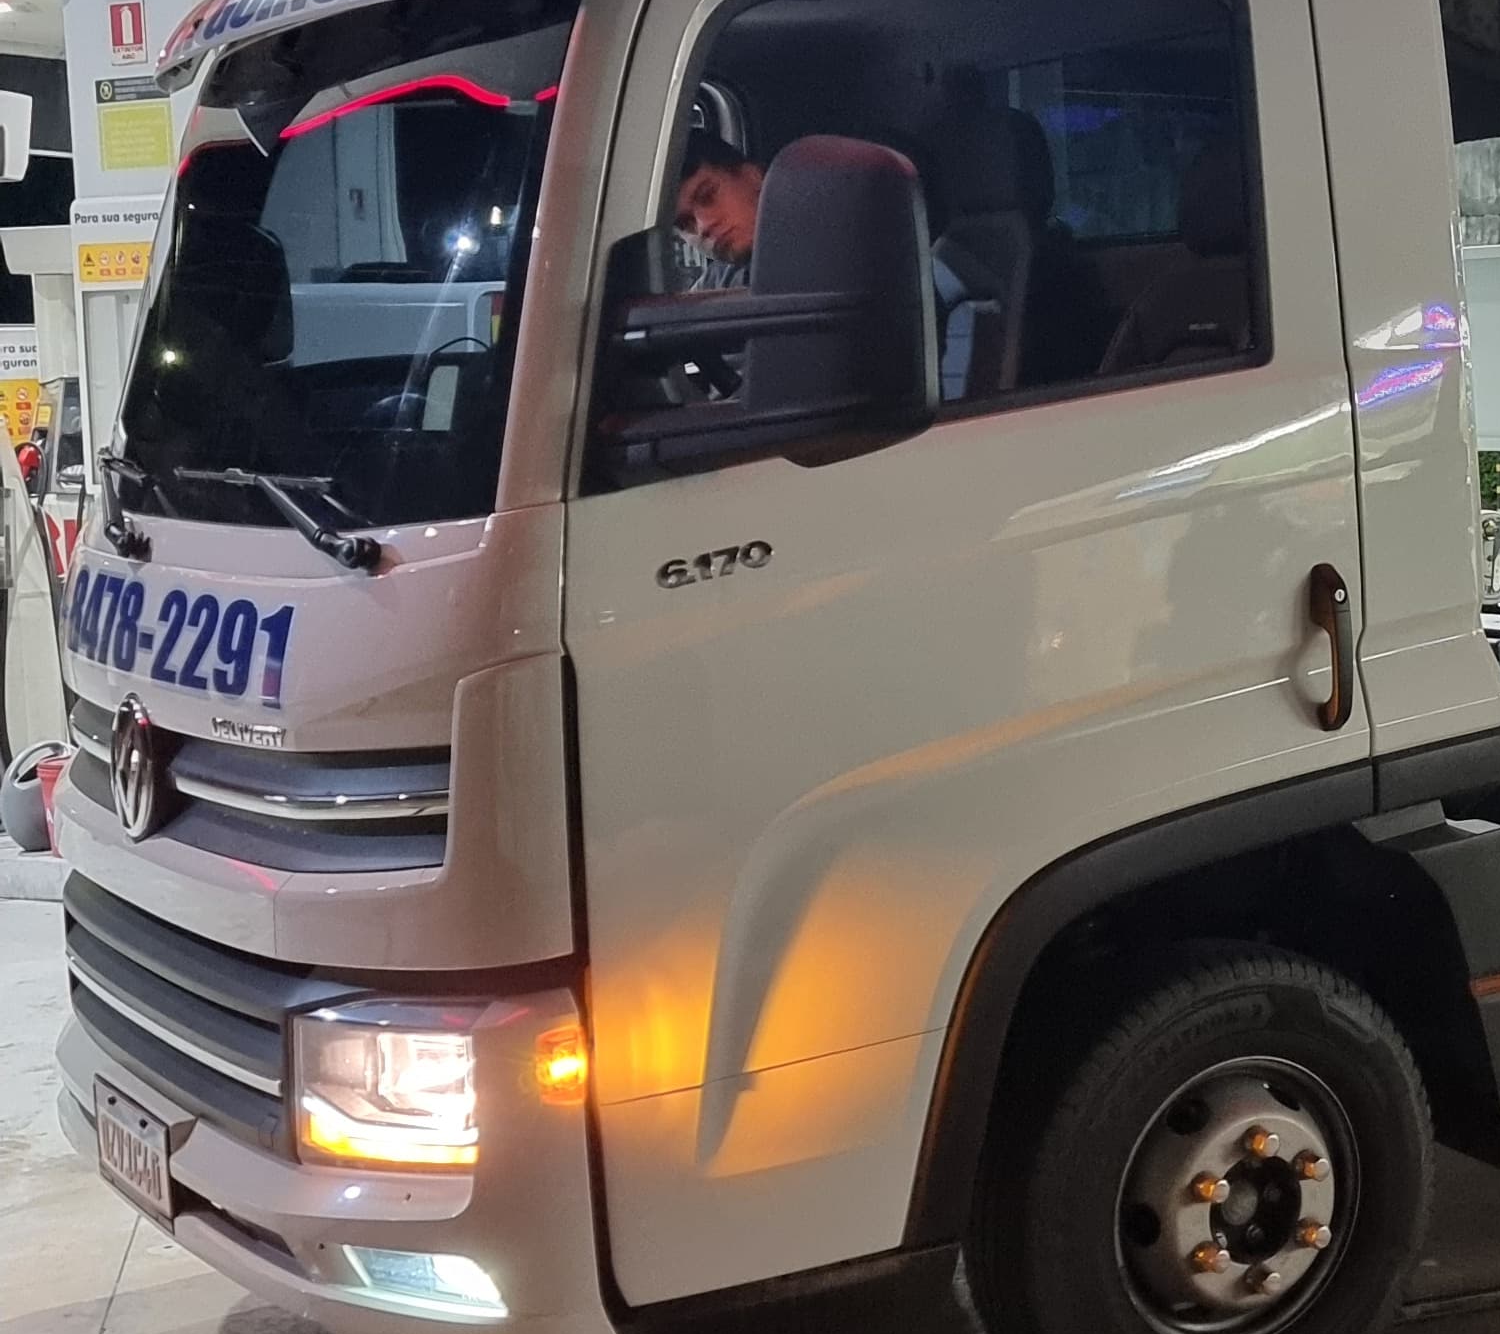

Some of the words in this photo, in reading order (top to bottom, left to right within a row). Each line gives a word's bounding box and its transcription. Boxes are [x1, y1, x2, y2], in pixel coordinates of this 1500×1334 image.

[74, 213, 99, 224] Para
[102, 214, 120, 223] sua
[123, 212, 159, 224] segura
[0, 359, 38, 371] guran
[212, 717, 287, 748] DELIVERY
